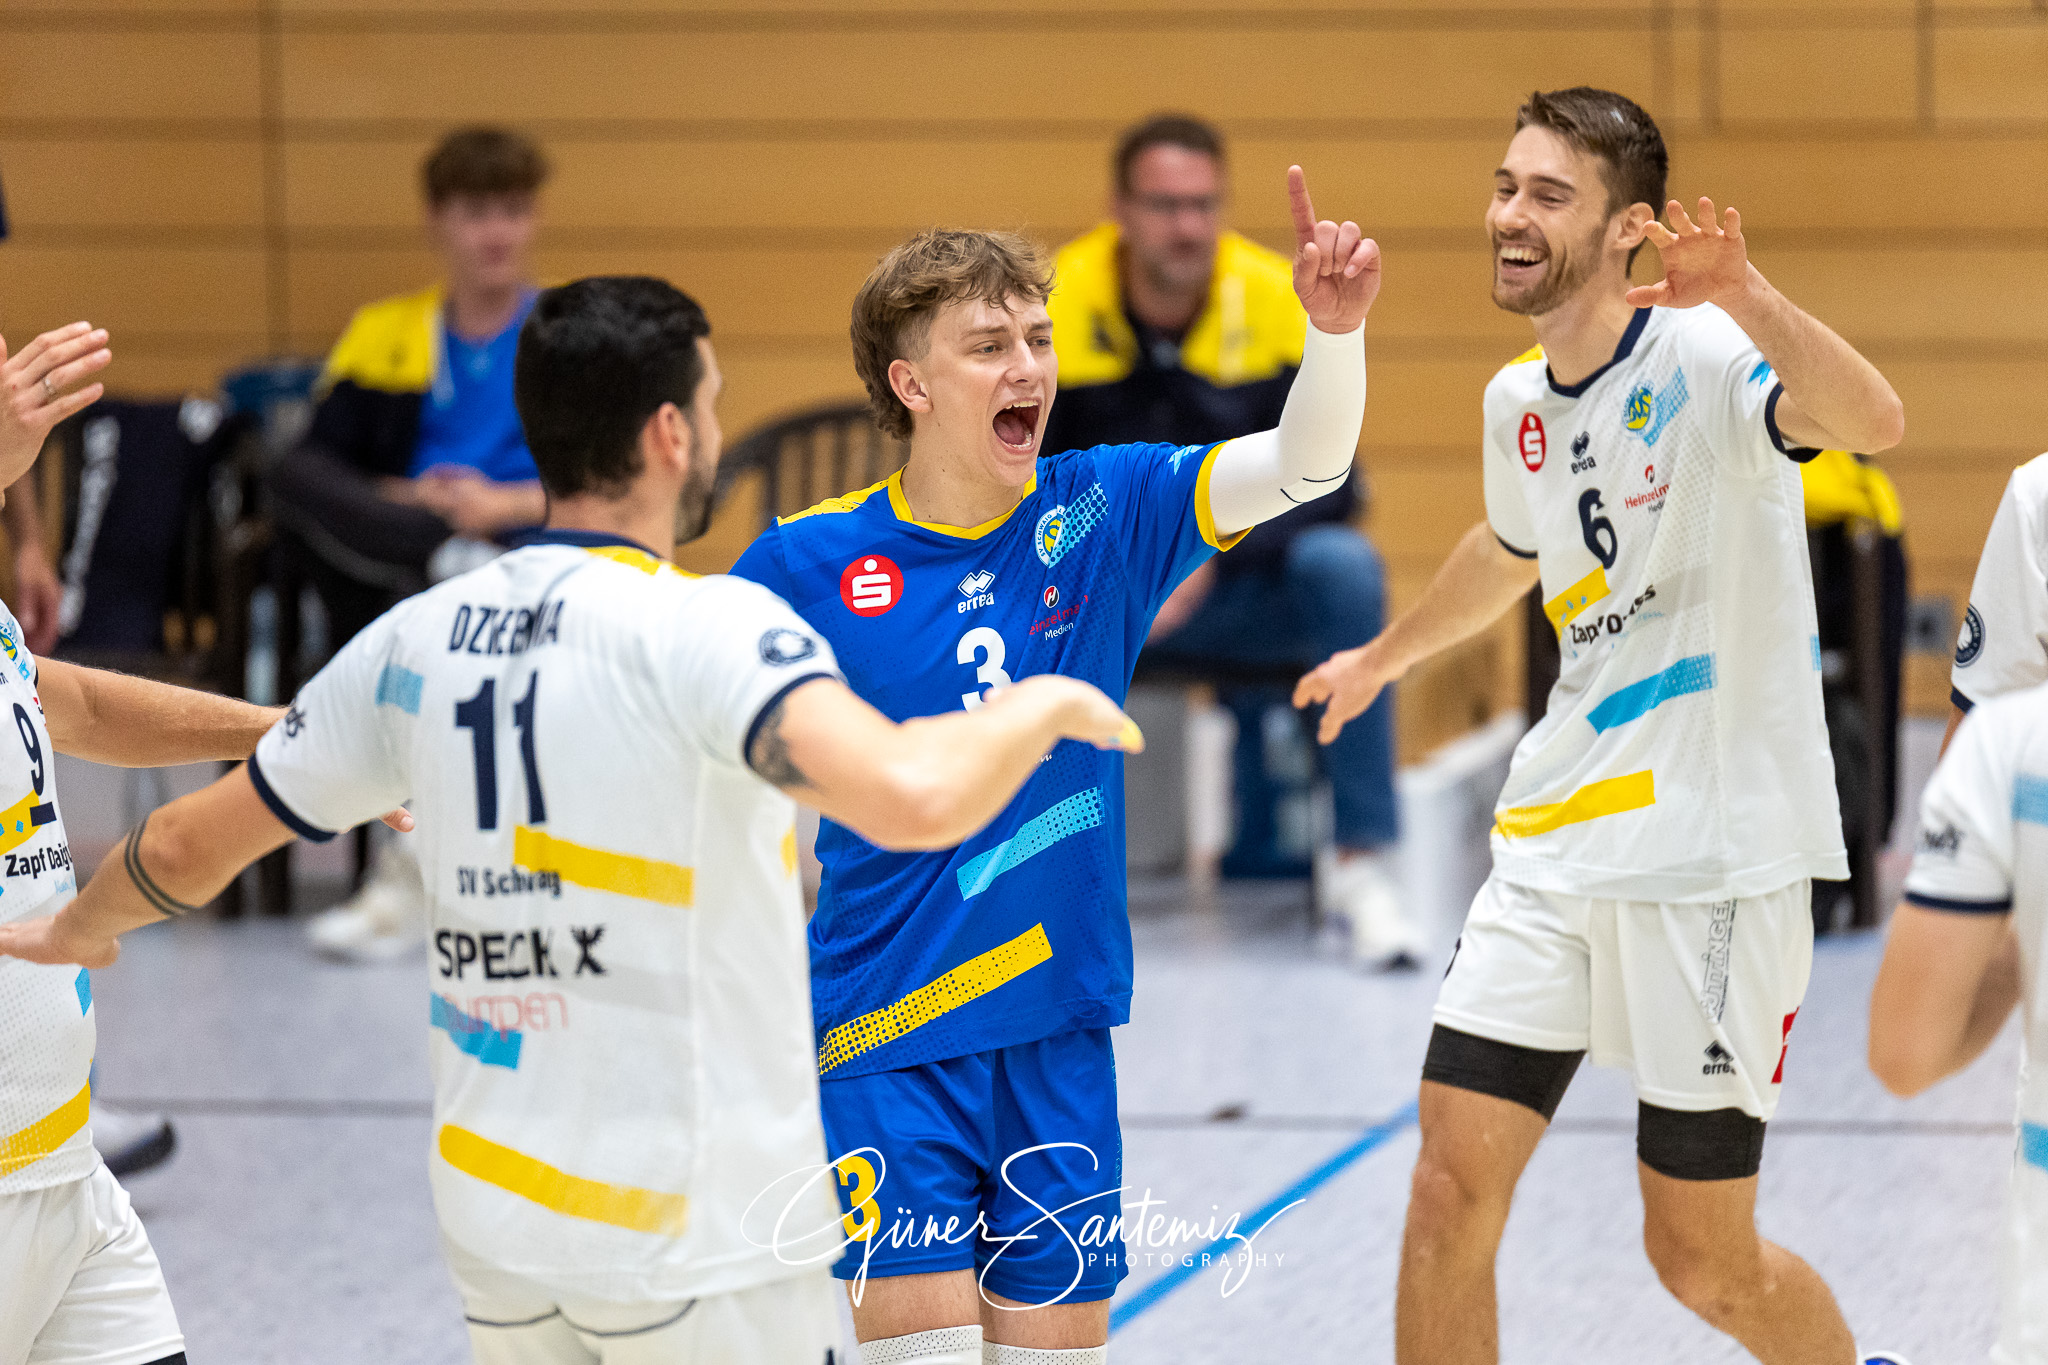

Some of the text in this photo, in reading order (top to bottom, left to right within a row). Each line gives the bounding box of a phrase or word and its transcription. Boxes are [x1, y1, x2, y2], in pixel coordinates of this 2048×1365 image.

[1578, 488, 1618, 569] 6
[957, 627, 1012, 714] 3
[1044, 622, 1074, 641] Medien
[13, 702, 44, 796] 9
[455, 669, 547, 830] 11
[5, 847, 46, 879] Zapf
[434, 926, 558, 981] SPECK
[840, 1156, 882, 1242] 3
